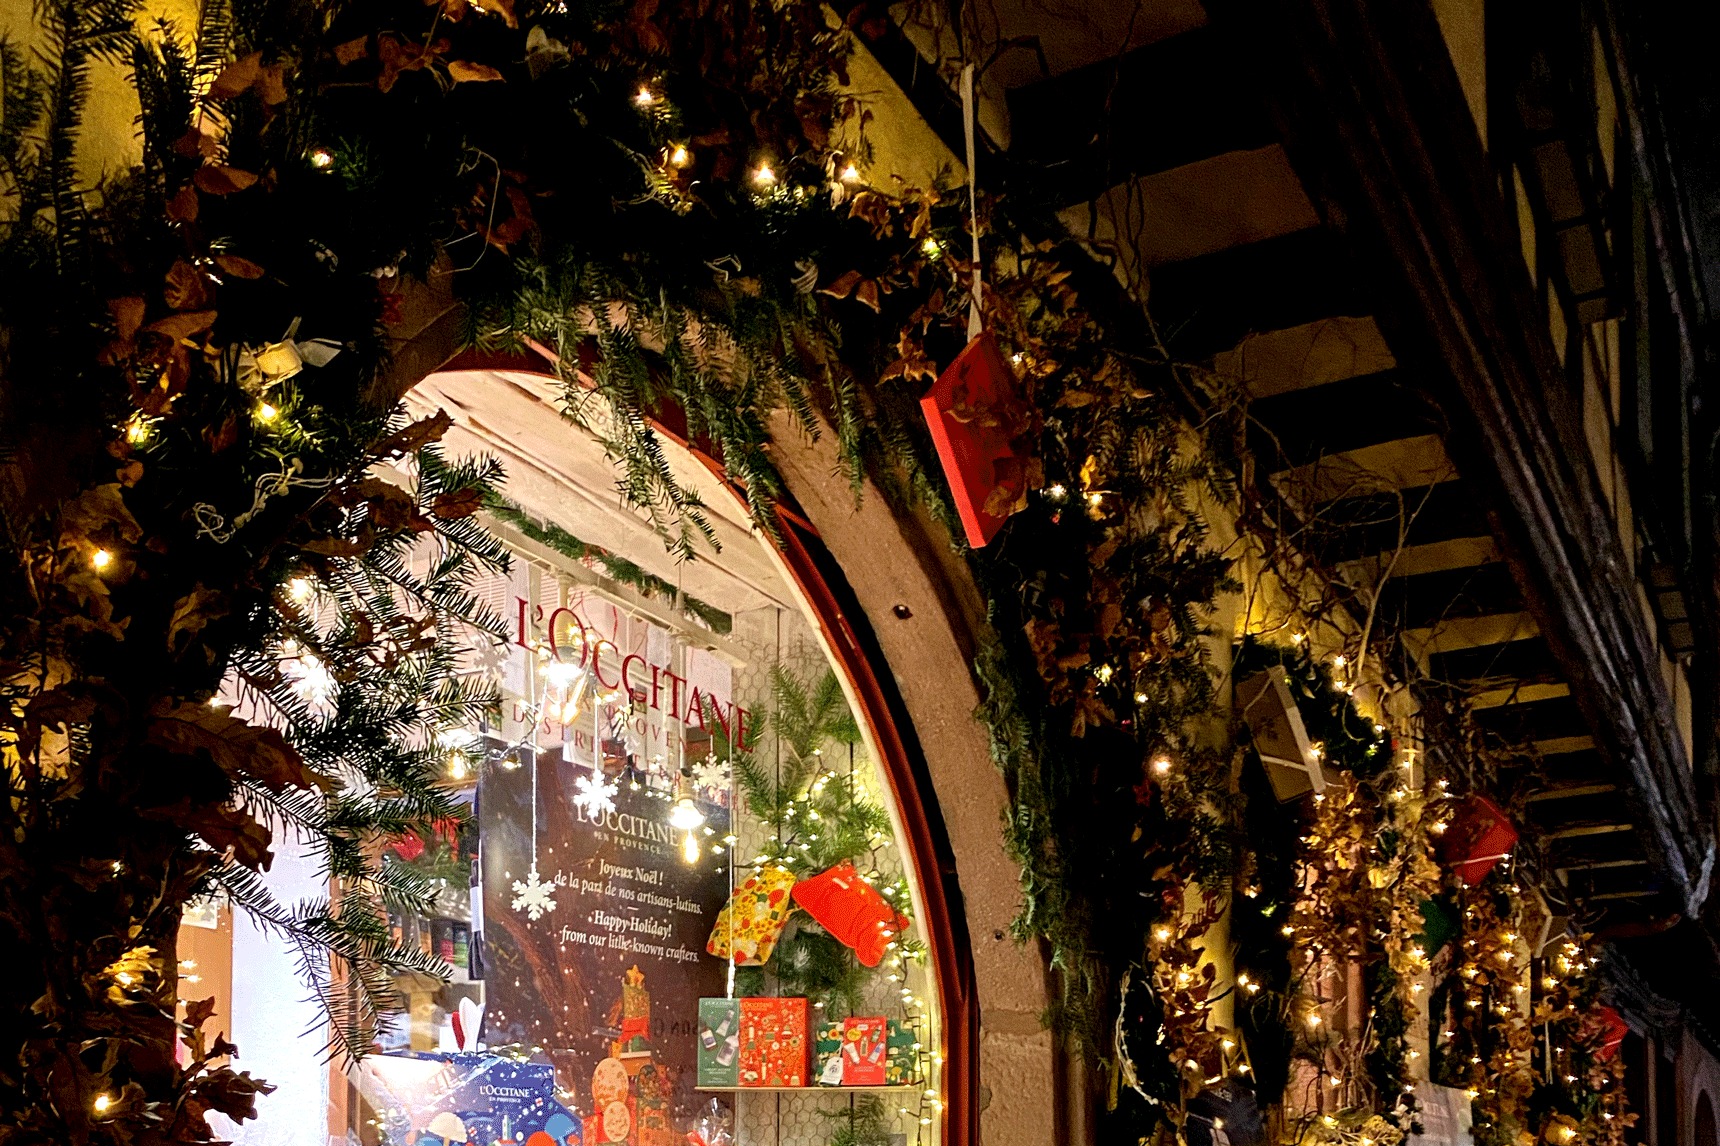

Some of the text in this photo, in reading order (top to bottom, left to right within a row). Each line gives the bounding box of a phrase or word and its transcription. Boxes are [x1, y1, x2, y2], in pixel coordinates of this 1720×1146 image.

[515, 596, 753, 753] L'OCCITANE
[576, 800, 679, 847] L'OCCITANE
[613, 836, 662, 856] PROVENCE
[599, 858, 634, 879] Joyeux
[634, 866, 658, 885] Noël
[554, 869, 703, 915] de la part de nos artisans-lutins.
[594, 909, 672, 941] Happy Holiday!
[560, 924, 587, 944] from
[589, 934, 607, 948] our
[665, 943, 700, 964] crafters.
[480, 1084, 530, 1098] L'OCCITANE
